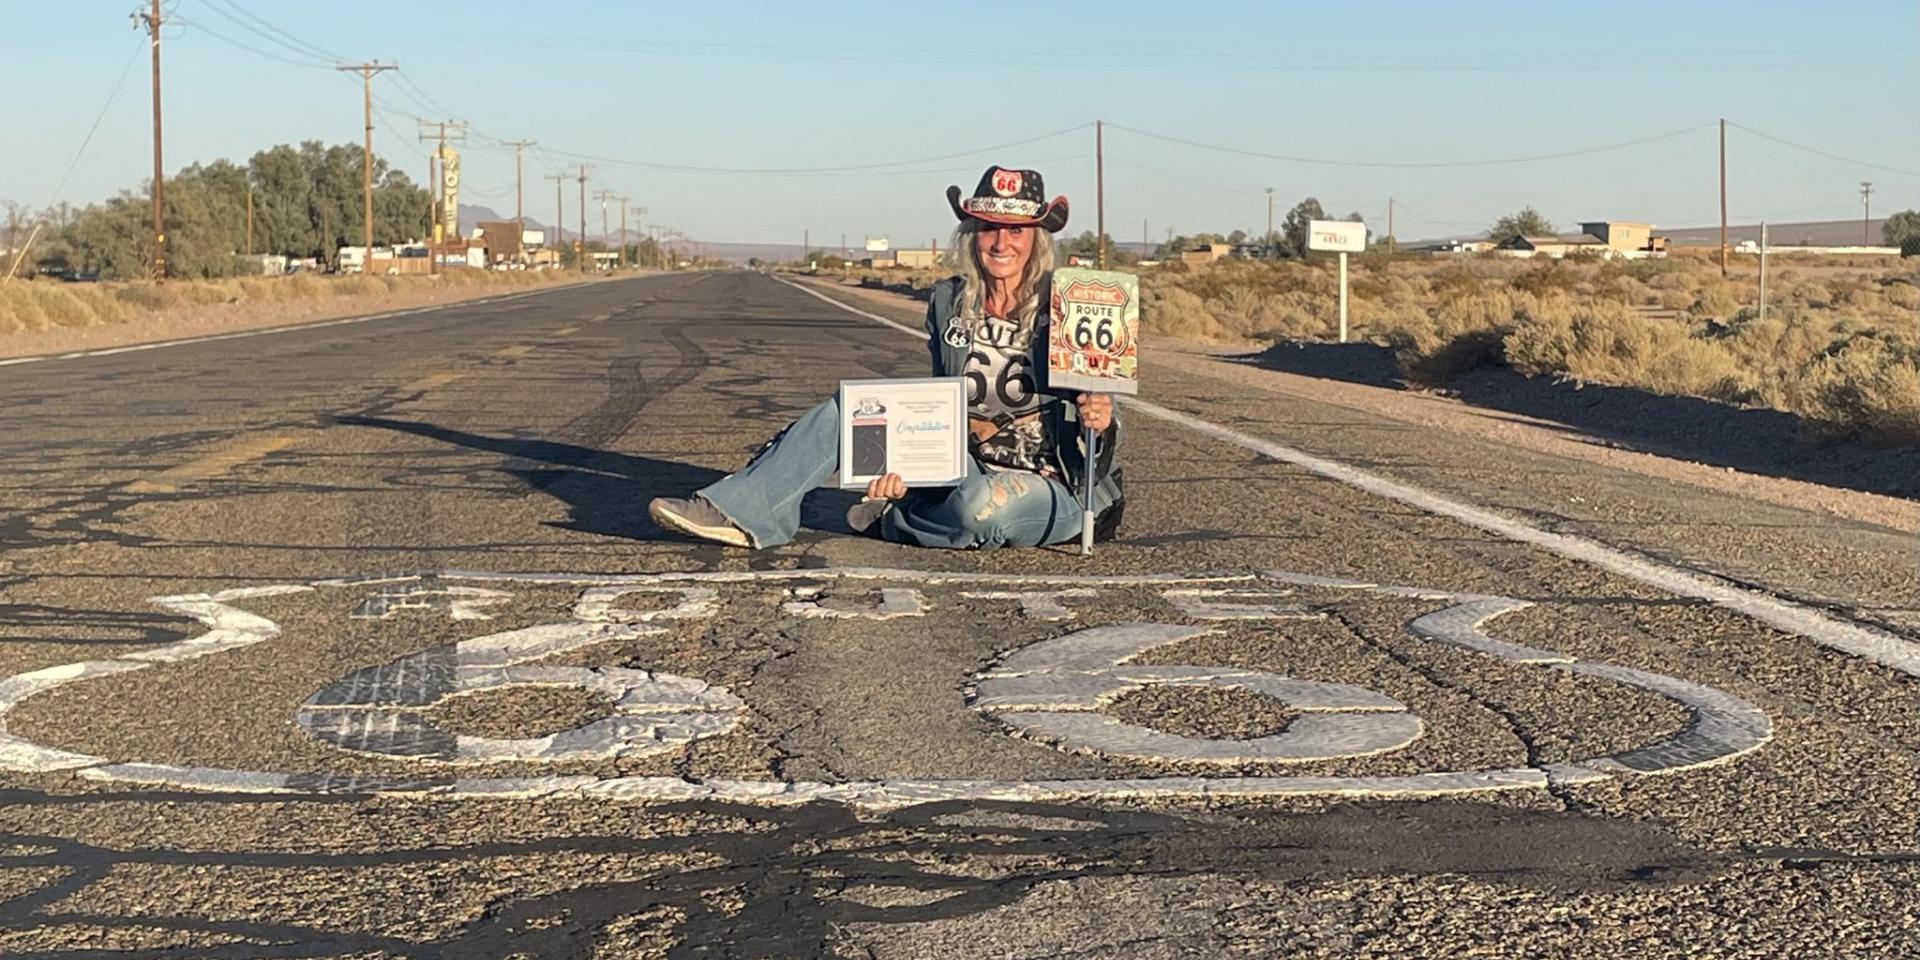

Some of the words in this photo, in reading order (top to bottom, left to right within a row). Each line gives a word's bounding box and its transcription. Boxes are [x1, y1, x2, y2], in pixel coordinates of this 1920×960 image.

[996, 178, 1016, 192] 66
[1072, 288, 1118, 303] HISTORIC
[1076, 305, 1113, 316] ROUTE
[951, 333, 967, 345] 66
[1075, 316, 1113, 350] 66
[963, 351, 1036, 408] 66
[350, 585, 1323, 621] ROUTE
[302, 621, 1424, 764] 66
